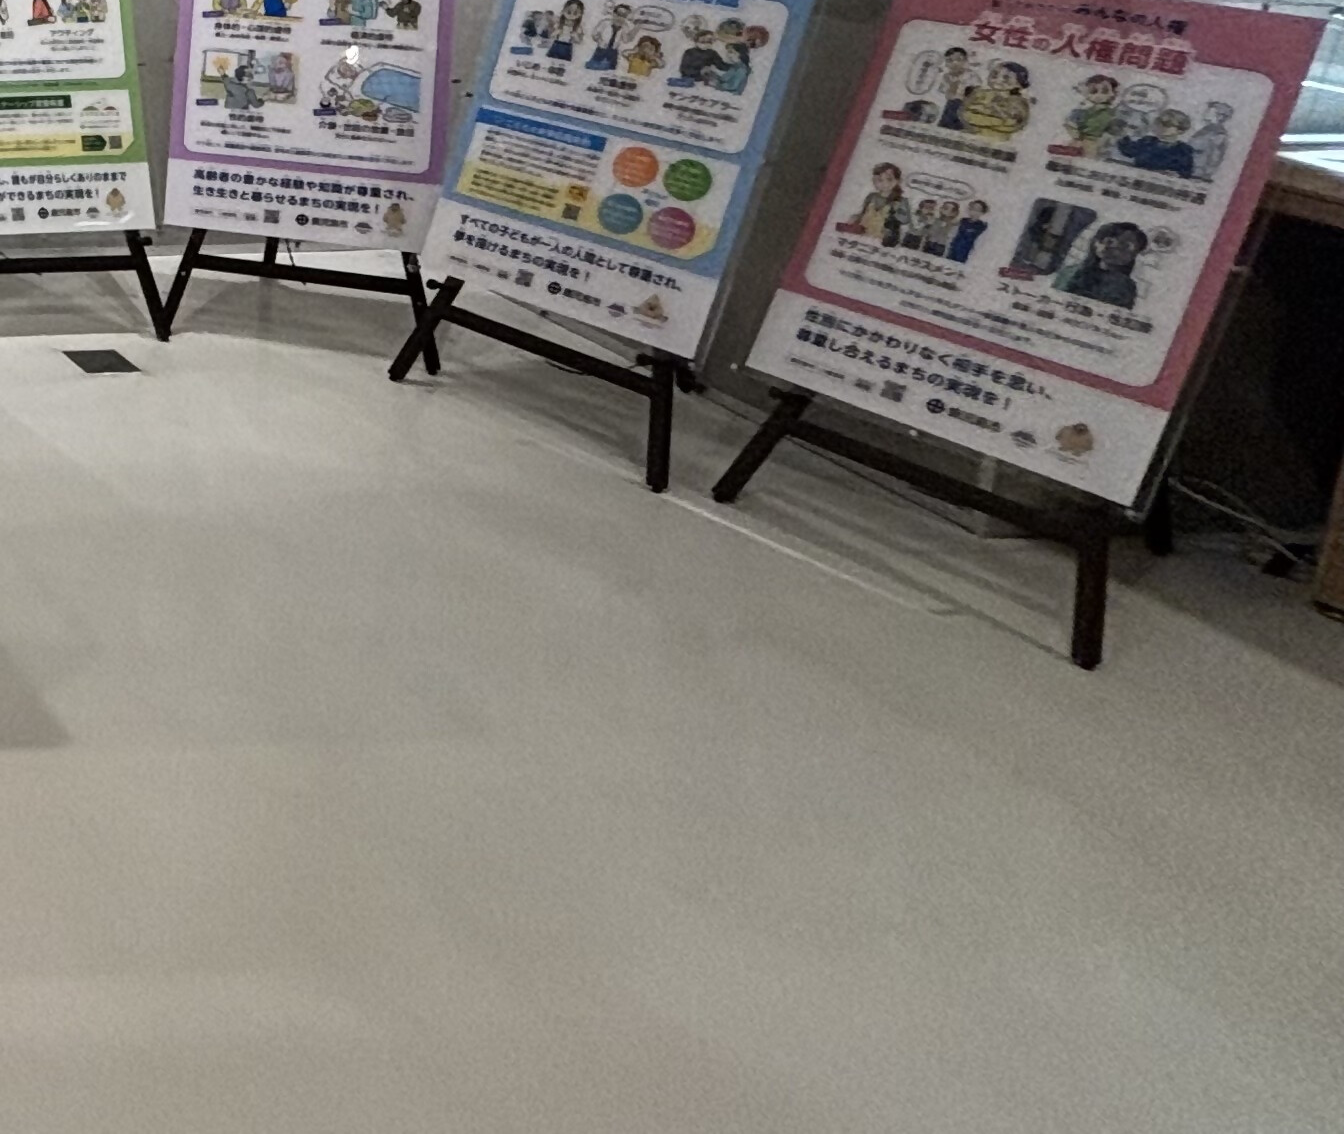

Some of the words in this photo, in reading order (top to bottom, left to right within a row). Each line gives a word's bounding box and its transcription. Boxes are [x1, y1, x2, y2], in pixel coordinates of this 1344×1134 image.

[969, 20, 1190, 77] 女性の人権問題
[193, 185, 380, 214] 生き生きと暮らせるまちの実現を！
[194, 169, 415, 201] 高齢者の豊かな経験や知識が尊重され、
